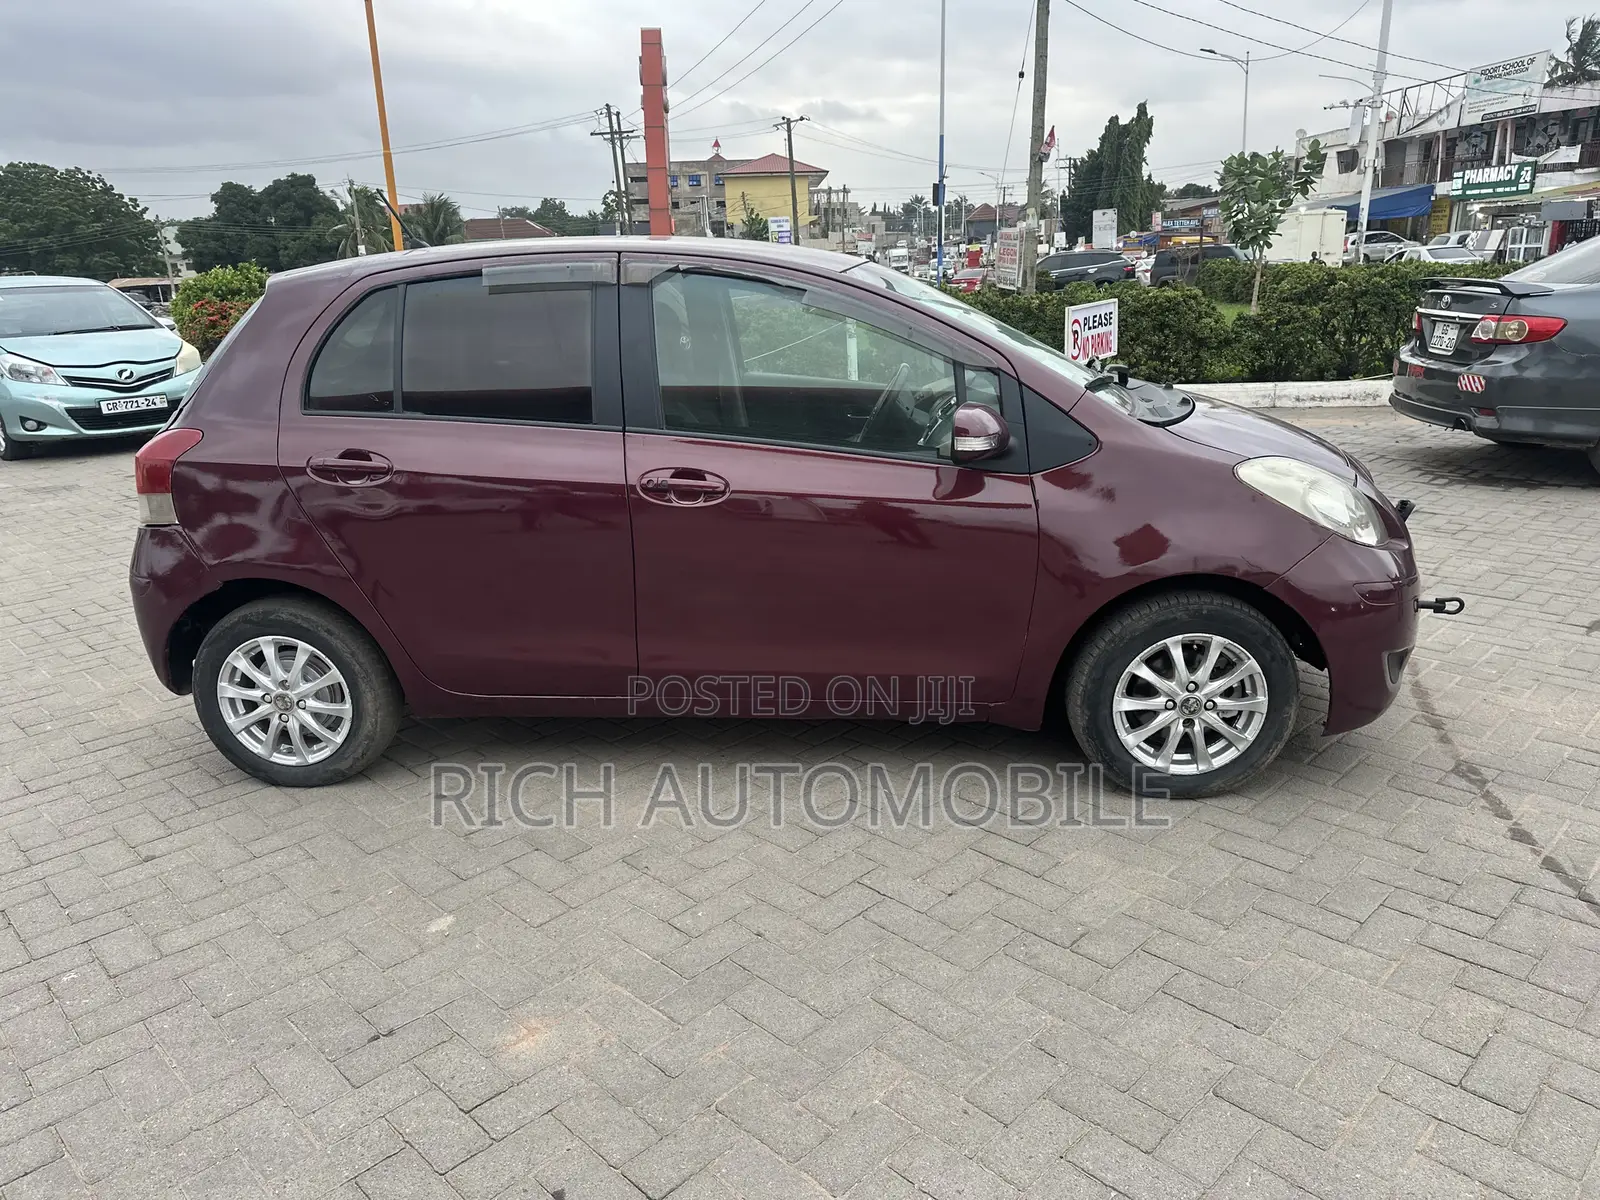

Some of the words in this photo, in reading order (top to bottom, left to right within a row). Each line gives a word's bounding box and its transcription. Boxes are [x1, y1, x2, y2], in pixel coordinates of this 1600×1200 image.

[1502, 60, 1526, 71] SCHOOL
[1526, 57, 1536, 66] OF
[1512, 66, 1529, 75] DESIGN
[1463, 165, 1519, 184] PHARMACY
[1519, 170, 1532, 183] 24
[999, 247, 1018, 257] LEGON
[1083, 311, 1113, 332] PLEASE
[1082, 336, 1090, 360] NO
[1090, 330, 1113, 357] PARKING
[106, 401, 119, 411] CR
[122, 397, 157, 410] 771-24
